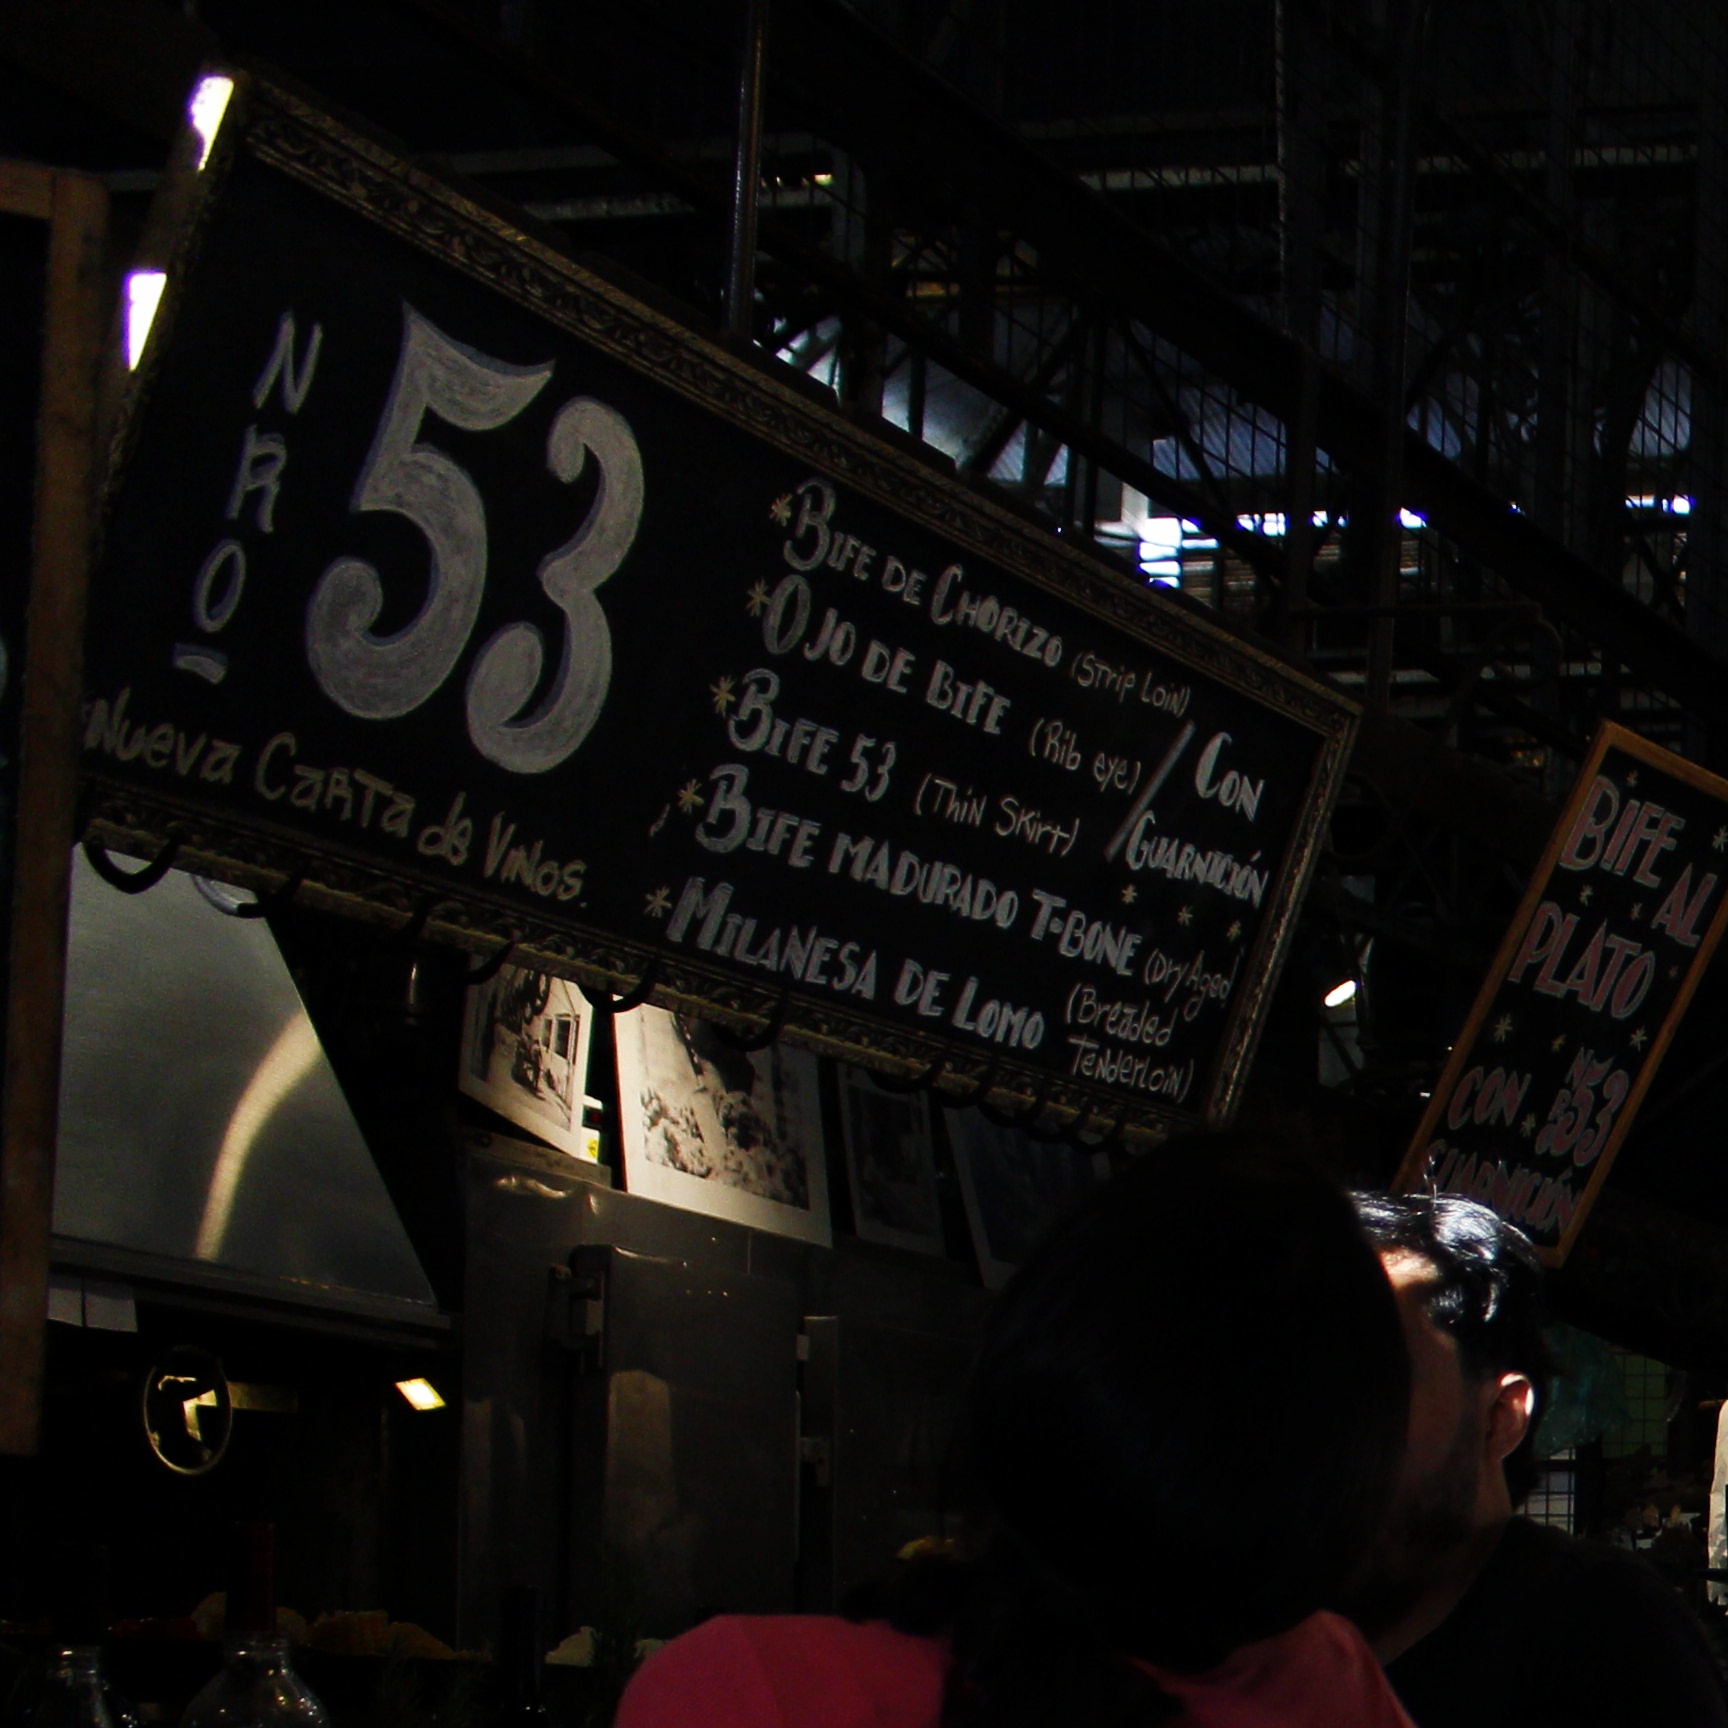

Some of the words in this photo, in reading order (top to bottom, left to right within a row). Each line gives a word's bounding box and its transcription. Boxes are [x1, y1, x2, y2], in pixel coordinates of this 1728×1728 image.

[305, 300, 645, 776] 53
[762, 574, 856, 666] OJO
[861, 638, 916, 694] DE
[925, 658, 1012, 735] BIFE
[881, 555, 928, 606] DE
[930, 563, 1063, 668] CHORIZO
[727, 667, 840, 776] BIFE
[841, 732, 897, 803] 53
[1194, 731, 1265, 823] CON
[695, 762, 822, 868] BIFE
[827, 831, 1020, 930] MADURADO
[1559, 774, 1687, 889] BIFE
[665, 876, 877, 1000] MILANESA
[894, 957, 952, 1017] DE
[952, 976, 1045, 1050] LOMO
[1506, 900, 1656, 1021] PLATO
[1650, 861, 1719, 949] AL
[1448, 1065, 1533, 1132] CON
